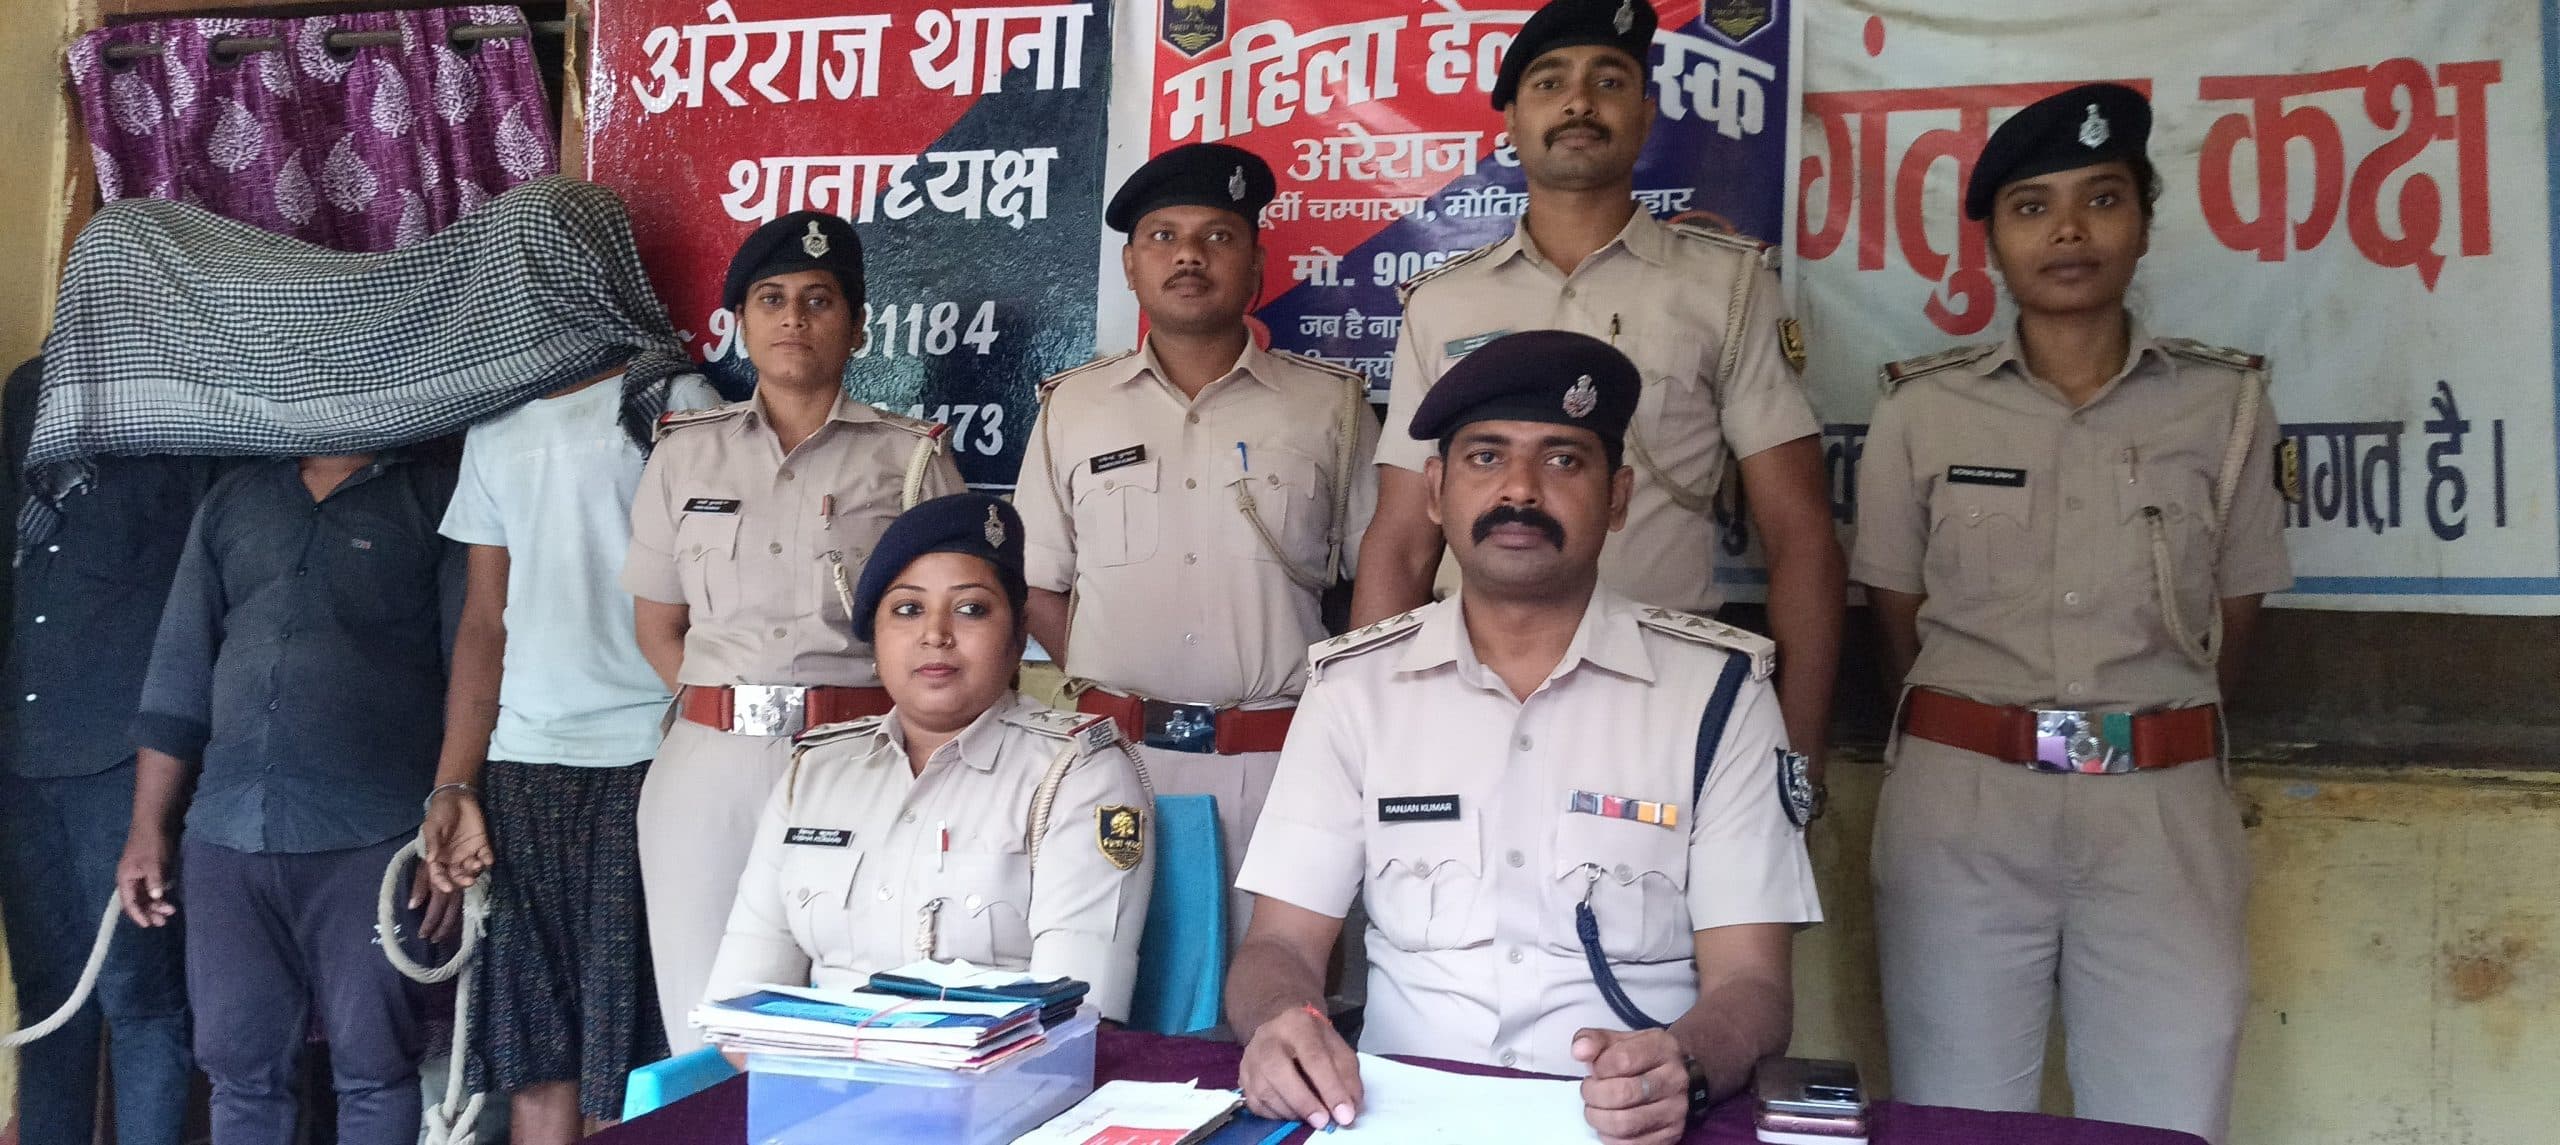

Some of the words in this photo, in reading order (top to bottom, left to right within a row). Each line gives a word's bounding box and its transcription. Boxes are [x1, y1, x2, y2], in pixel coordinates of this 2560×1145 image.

[631, 0, 892, 114] अरेराज
[909, 3, 1094, 96] थाना
[1163, 19, 1408, 143] महिला
[720, 147, 1059, 230] थानाध्यक्ष
[1287, 122, 1484, 182] अरेराज
[2197, 57, 2502, 292] कक्ष
[1288, 246, 1356, 288] मो.
[1300, 315, 1341, 338] जब
[1344, 308, 1365, 339] है
[2423, 380, 2471, 541] है
[1385, 804, 1420, 814] RANJAN
[1420, 802, 1453, 812] KUMAR
